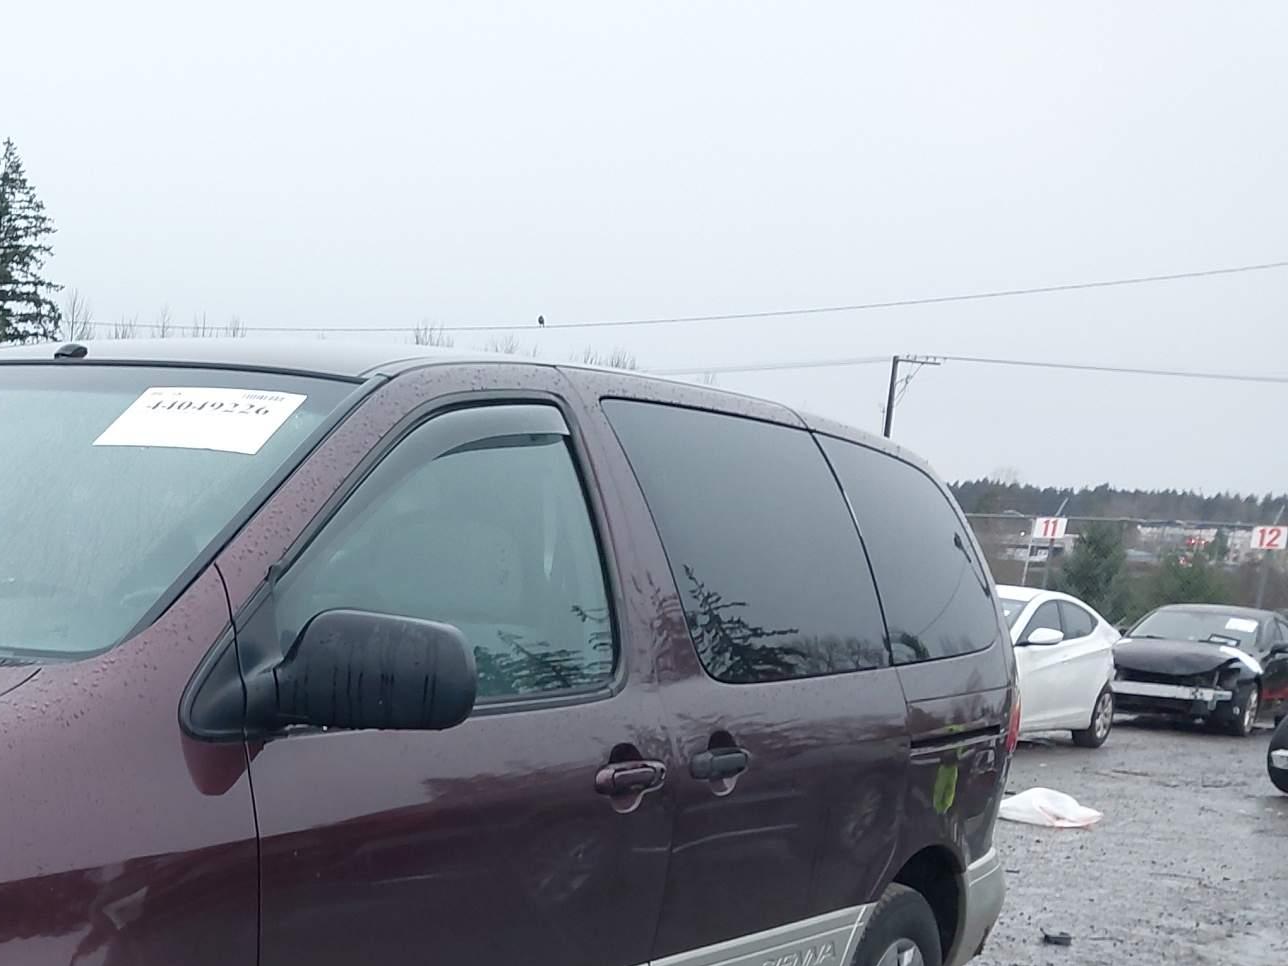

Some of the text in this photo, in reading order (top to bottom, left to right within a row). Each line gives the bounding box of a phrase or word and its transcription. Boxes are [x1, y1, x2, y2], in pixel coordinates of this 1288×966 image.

[146, 399, 270, 415] 44049226
[1043, 519, 1059, 537] 11
[1258, 528, 1281, 547] 12
